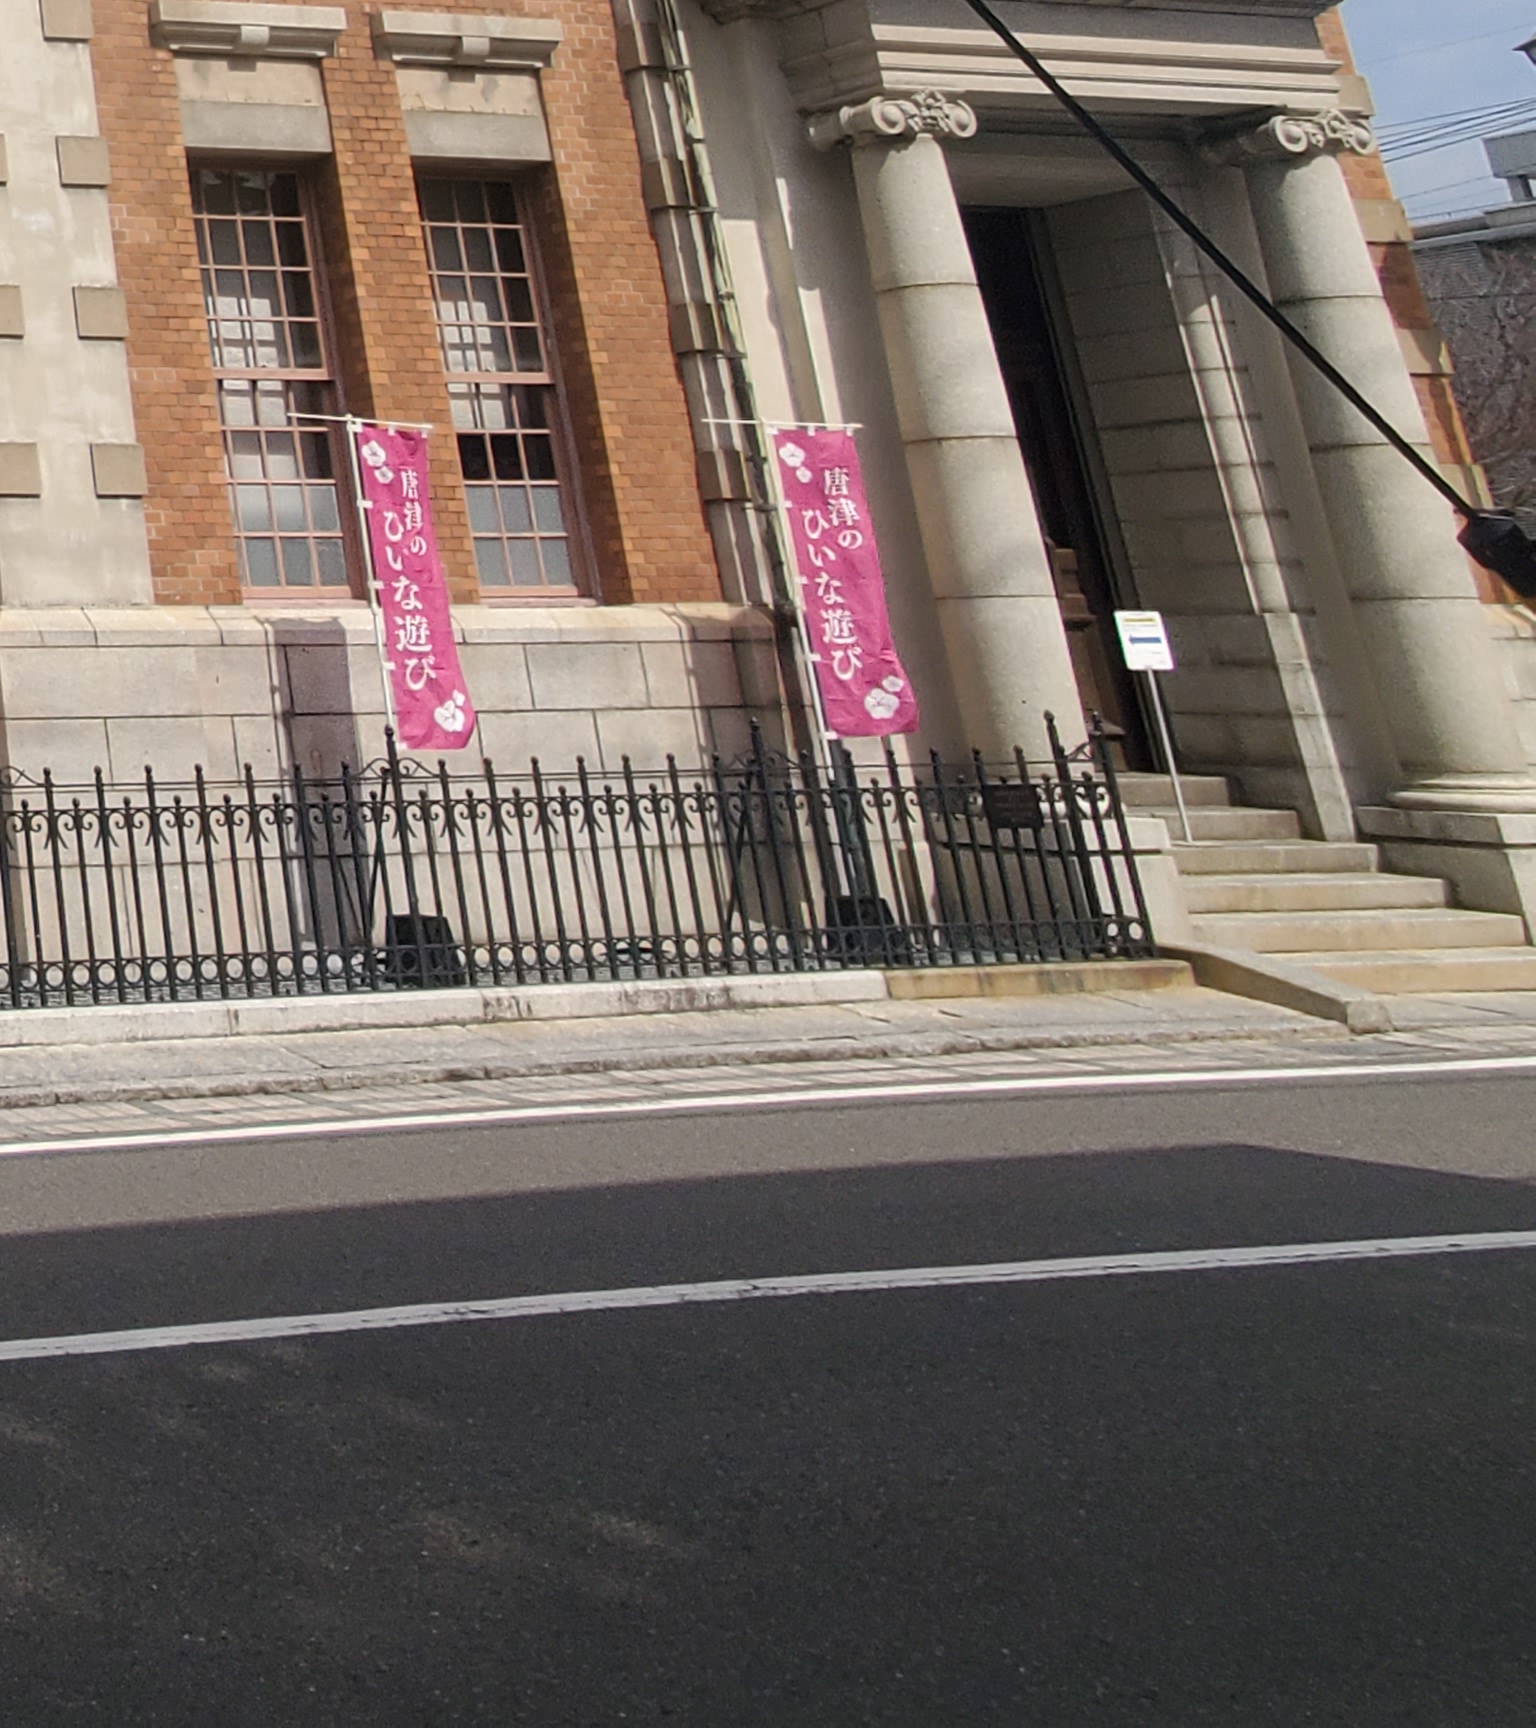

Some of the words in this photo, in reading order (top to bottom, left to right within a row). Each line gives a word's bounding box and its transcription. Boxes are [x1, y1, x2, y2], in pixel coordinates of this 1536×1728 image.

[400, 468, 428, 558] 唐津の
[824, 466, 864, 551] 唐津の
[383, 510, 437, 692] ひいな遊び
[801, 508, 864, 681] ひいな遊び
